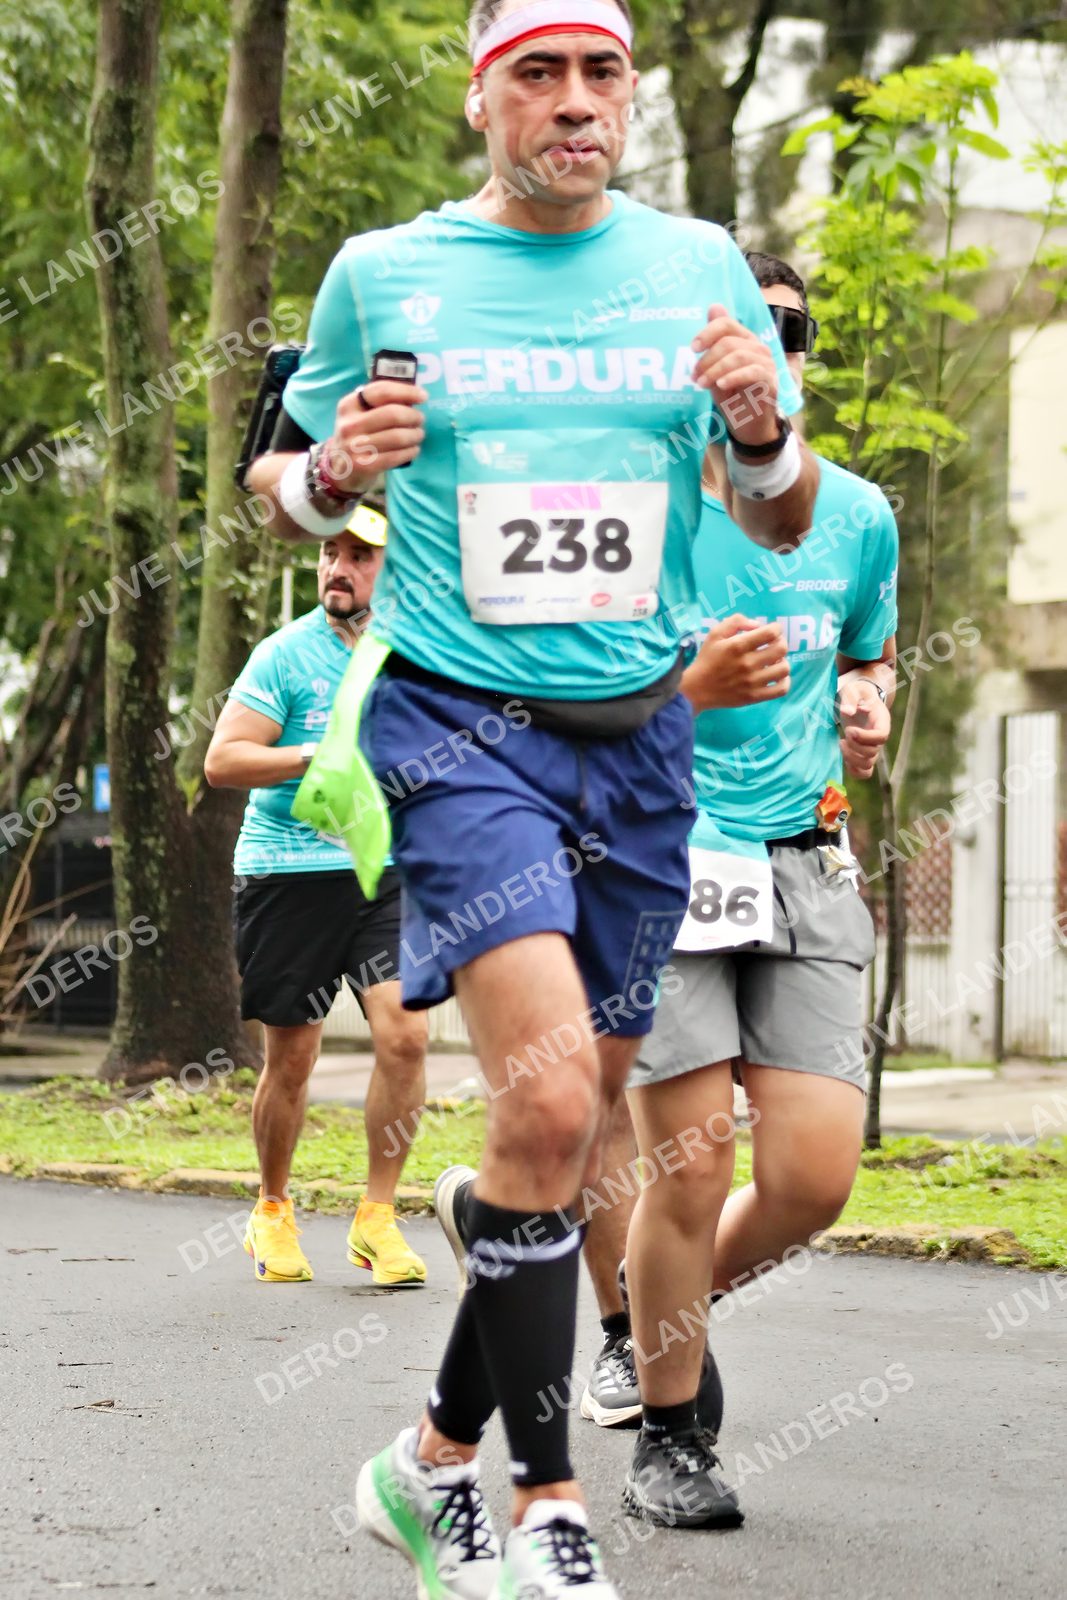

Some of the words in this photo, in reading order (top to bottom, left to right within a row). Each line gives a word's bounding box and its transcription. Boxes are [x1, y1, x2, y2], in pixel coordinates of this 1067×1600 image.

[629, 307, 702, 322] BROOKS
[414, 346, 708, 395] PERDURA
[500, 518, 632, 574] 238
[795, 579, 848, 592] BROOKS
[688, 878, 760, 927] 86
